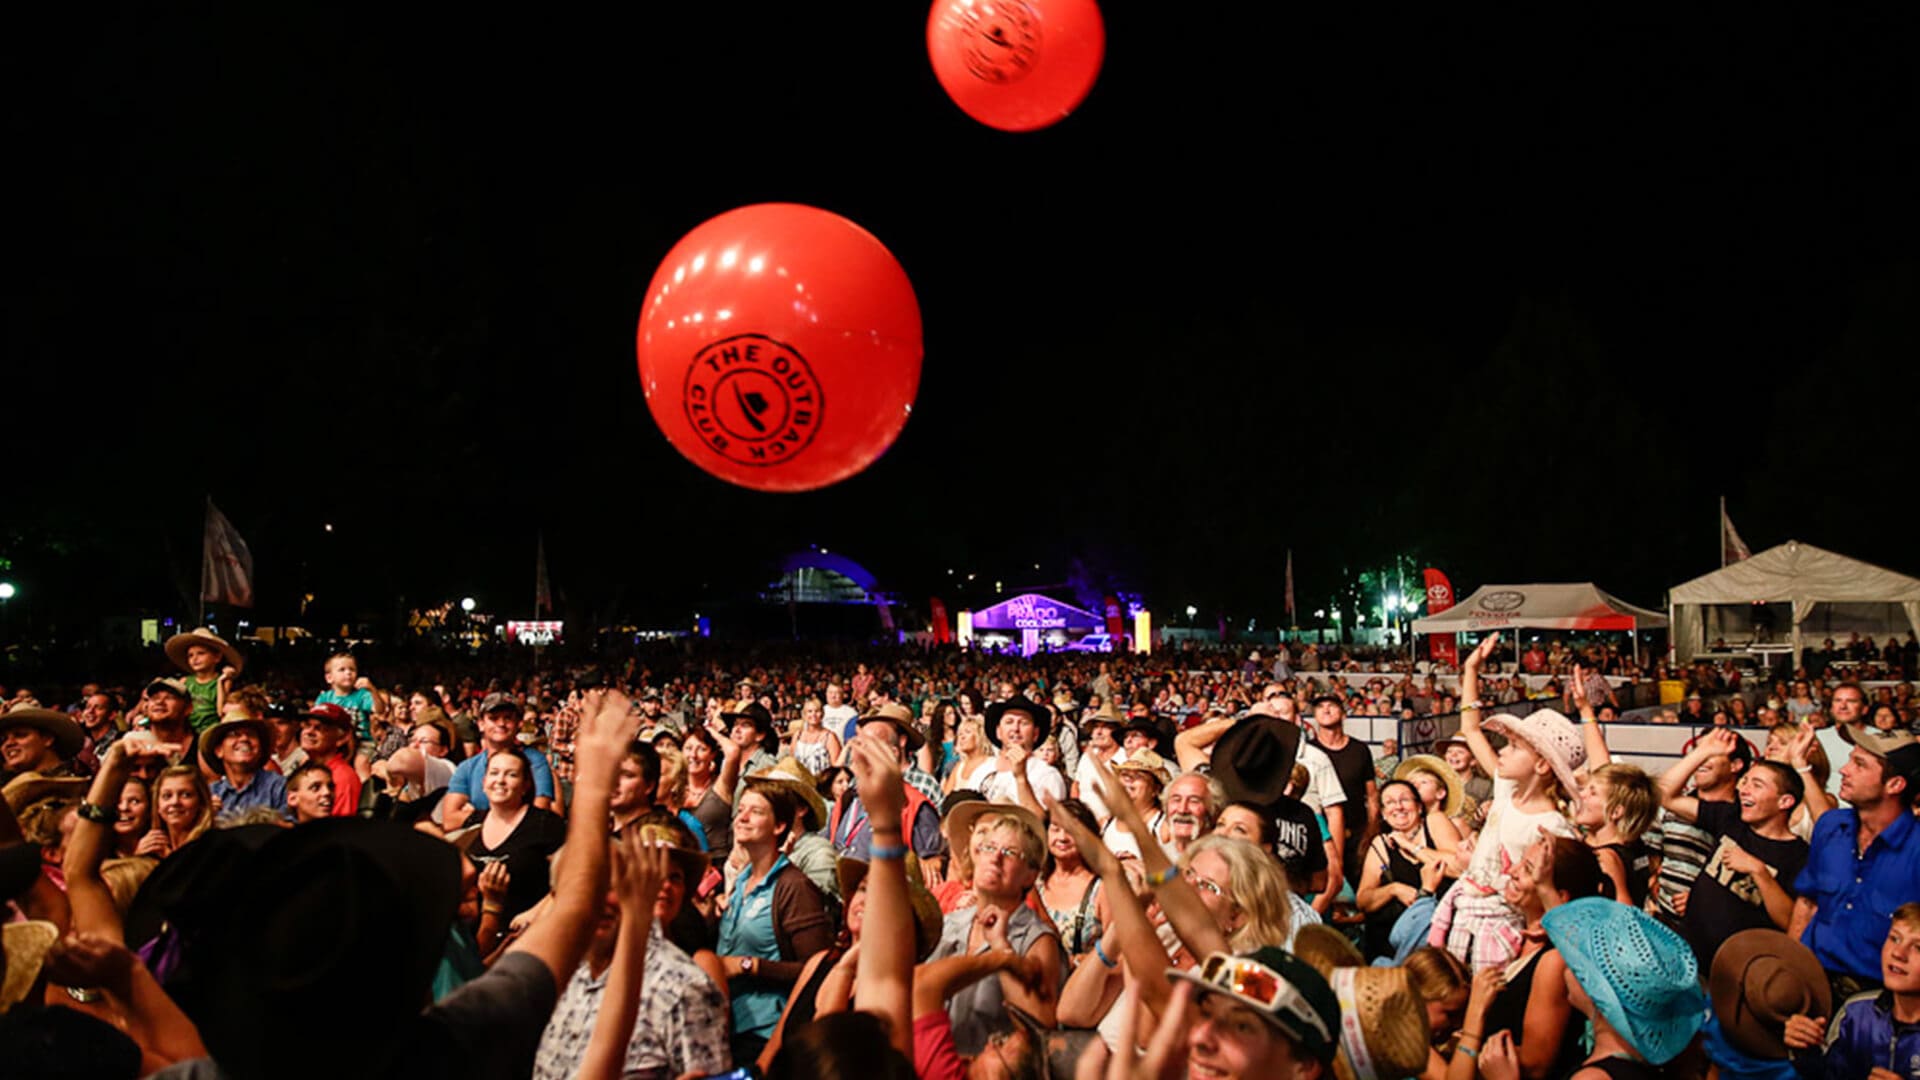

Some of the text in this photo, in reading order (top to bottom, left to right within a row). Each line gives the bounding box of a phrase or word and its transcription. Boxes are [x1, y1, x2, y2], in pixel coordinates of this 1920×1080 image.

[691, 344, 813, 459] THE OUTBACK CLUB
